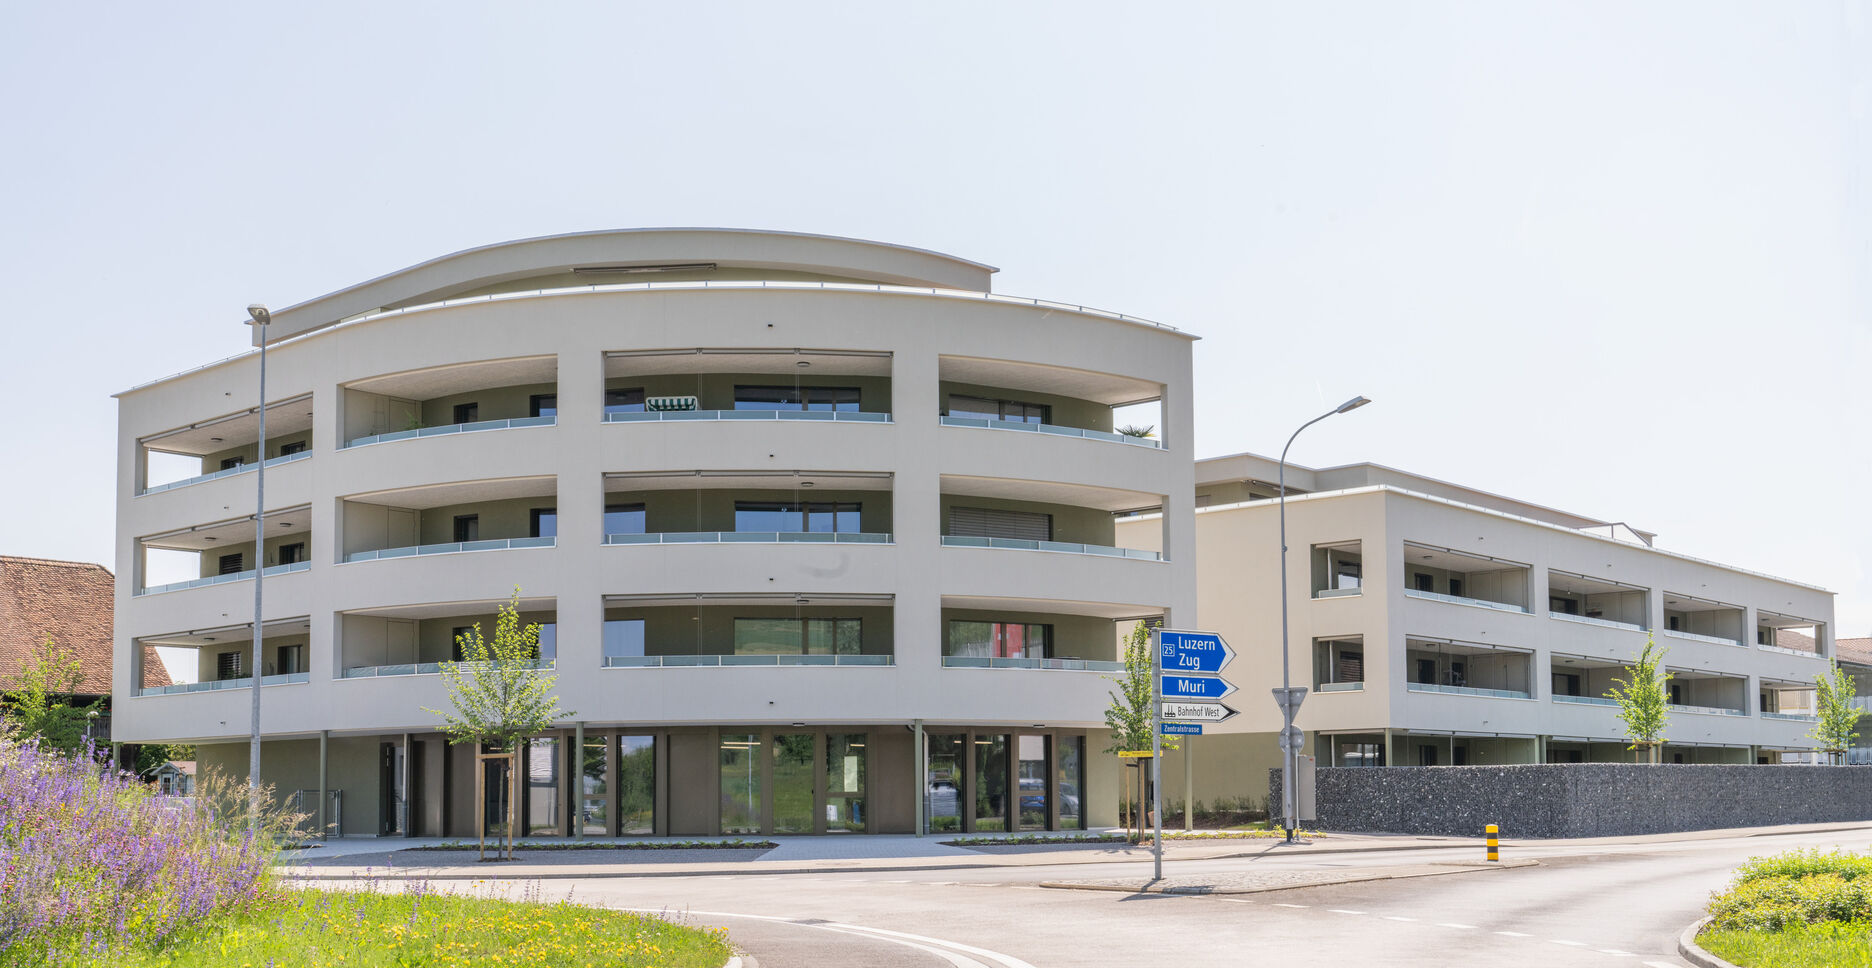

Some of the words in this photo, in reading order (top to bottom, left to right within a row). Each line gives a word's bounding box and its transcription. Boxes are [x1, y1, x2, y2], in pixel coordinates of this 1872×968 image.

[1178, 636, 1216, 651] Luzern
[1164, 645, 1173, 655] 25
[1178, 653, 1200, 670] Zug
[1178, 679, 1205, 693] Muri
[1177, 706, 1203, 717] Bahnhof
[1204, 707, 1220, 717] West
[1164, 724, 1200, 733] Zentralstrasse
